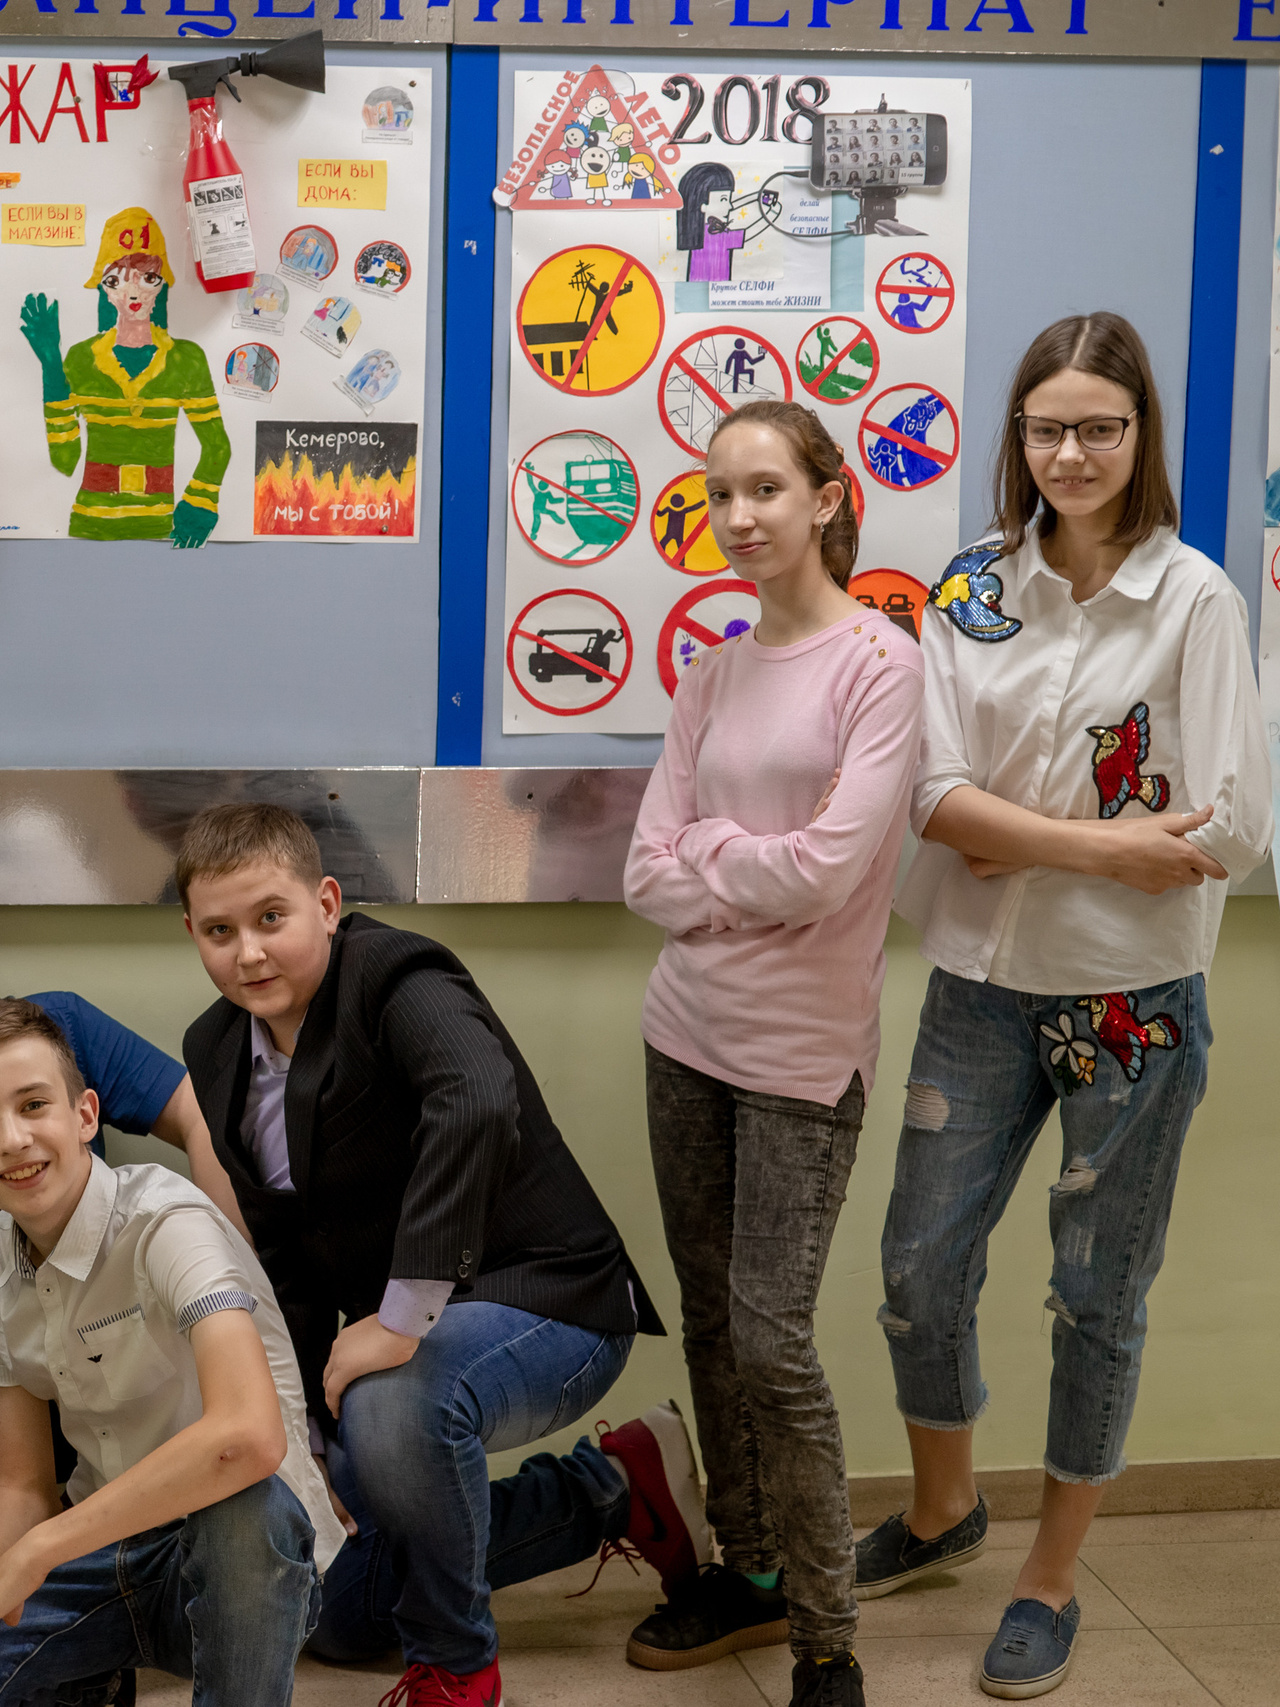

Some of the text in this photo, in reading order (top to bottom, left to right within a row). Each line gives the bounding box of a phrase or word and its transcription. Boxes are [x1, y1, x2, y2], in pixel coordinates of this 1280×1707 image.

[661, 73, 831, 146] 2018
[498, 69, 580, 196] БЕЗОПАСНОЕ
[624, 91, 681, 165] ЛЕТО
[305, 163, 374, 178] ЕСЛИ ВЫ
[305, 186, 357, 202] ДОМА:
[799, 198, 820, 207] делай
[8, 206, 83, 222] ЕСЛИ ВЫ В
[9, 226, 81, 240] МАГАЗИНЕ:
[711, 280, 775, 293] Крутое СЕЛФИ
[766, 298, 782, 306] тебе
[784, 296, 821, 306] ЖИЗНИ
[286, 428, 385, 455] Кемерово,
